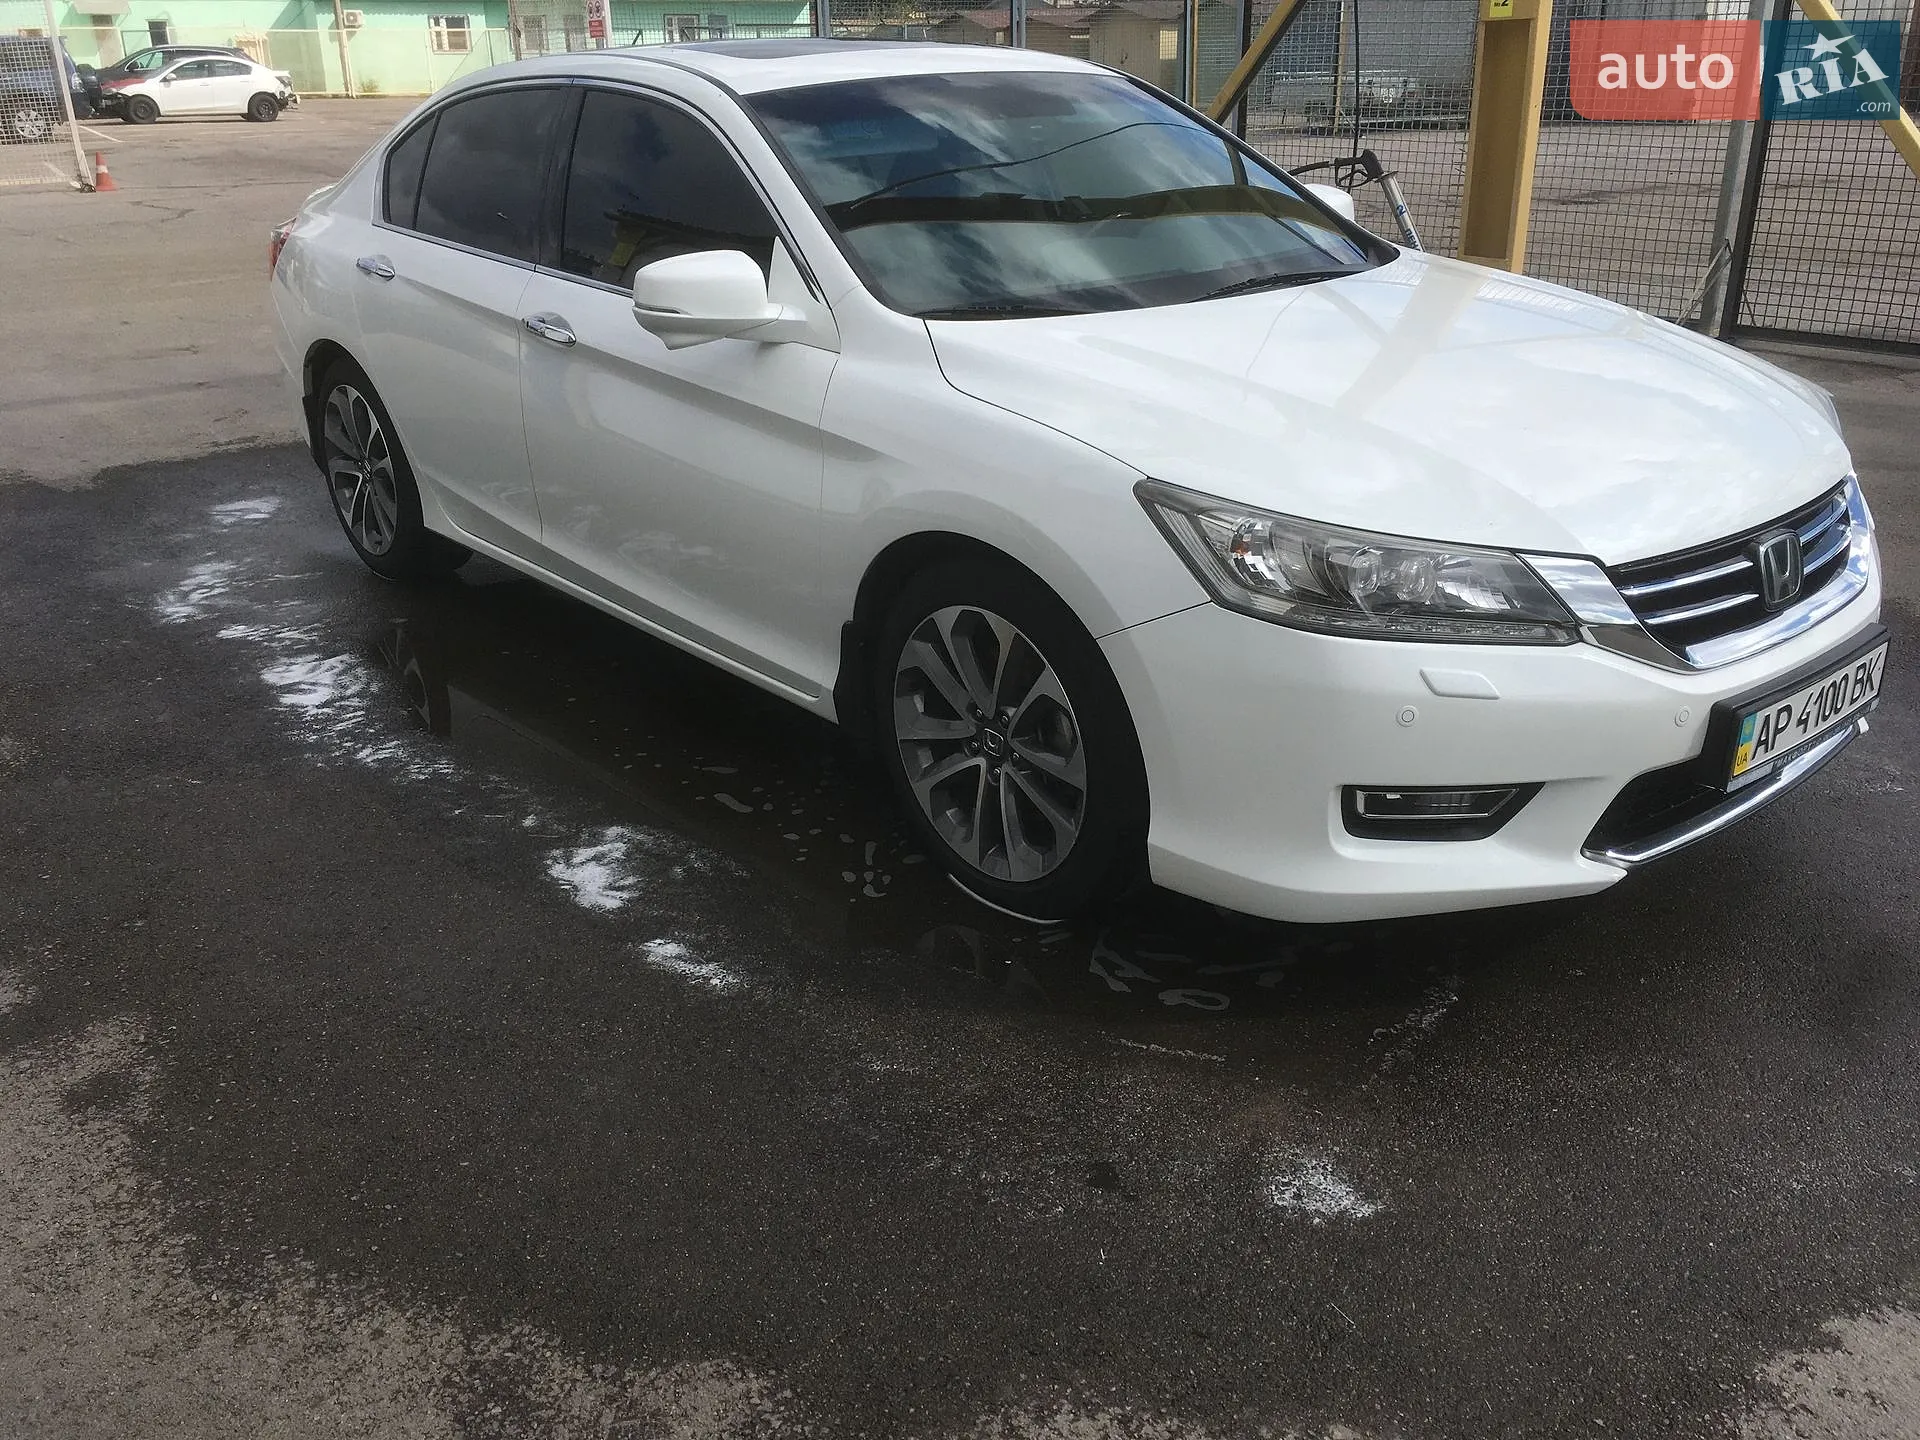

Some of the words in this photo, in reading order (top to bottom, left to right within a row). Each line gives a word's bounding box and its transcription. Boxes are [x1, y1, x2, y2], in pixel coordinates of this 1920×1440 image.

[1751, 703, 1793, 761] AP
[1795, 673, 1849, 735] 4100
[1849, 652, 1883, 707] BK
[1736, 752, 1749, 767] UA
